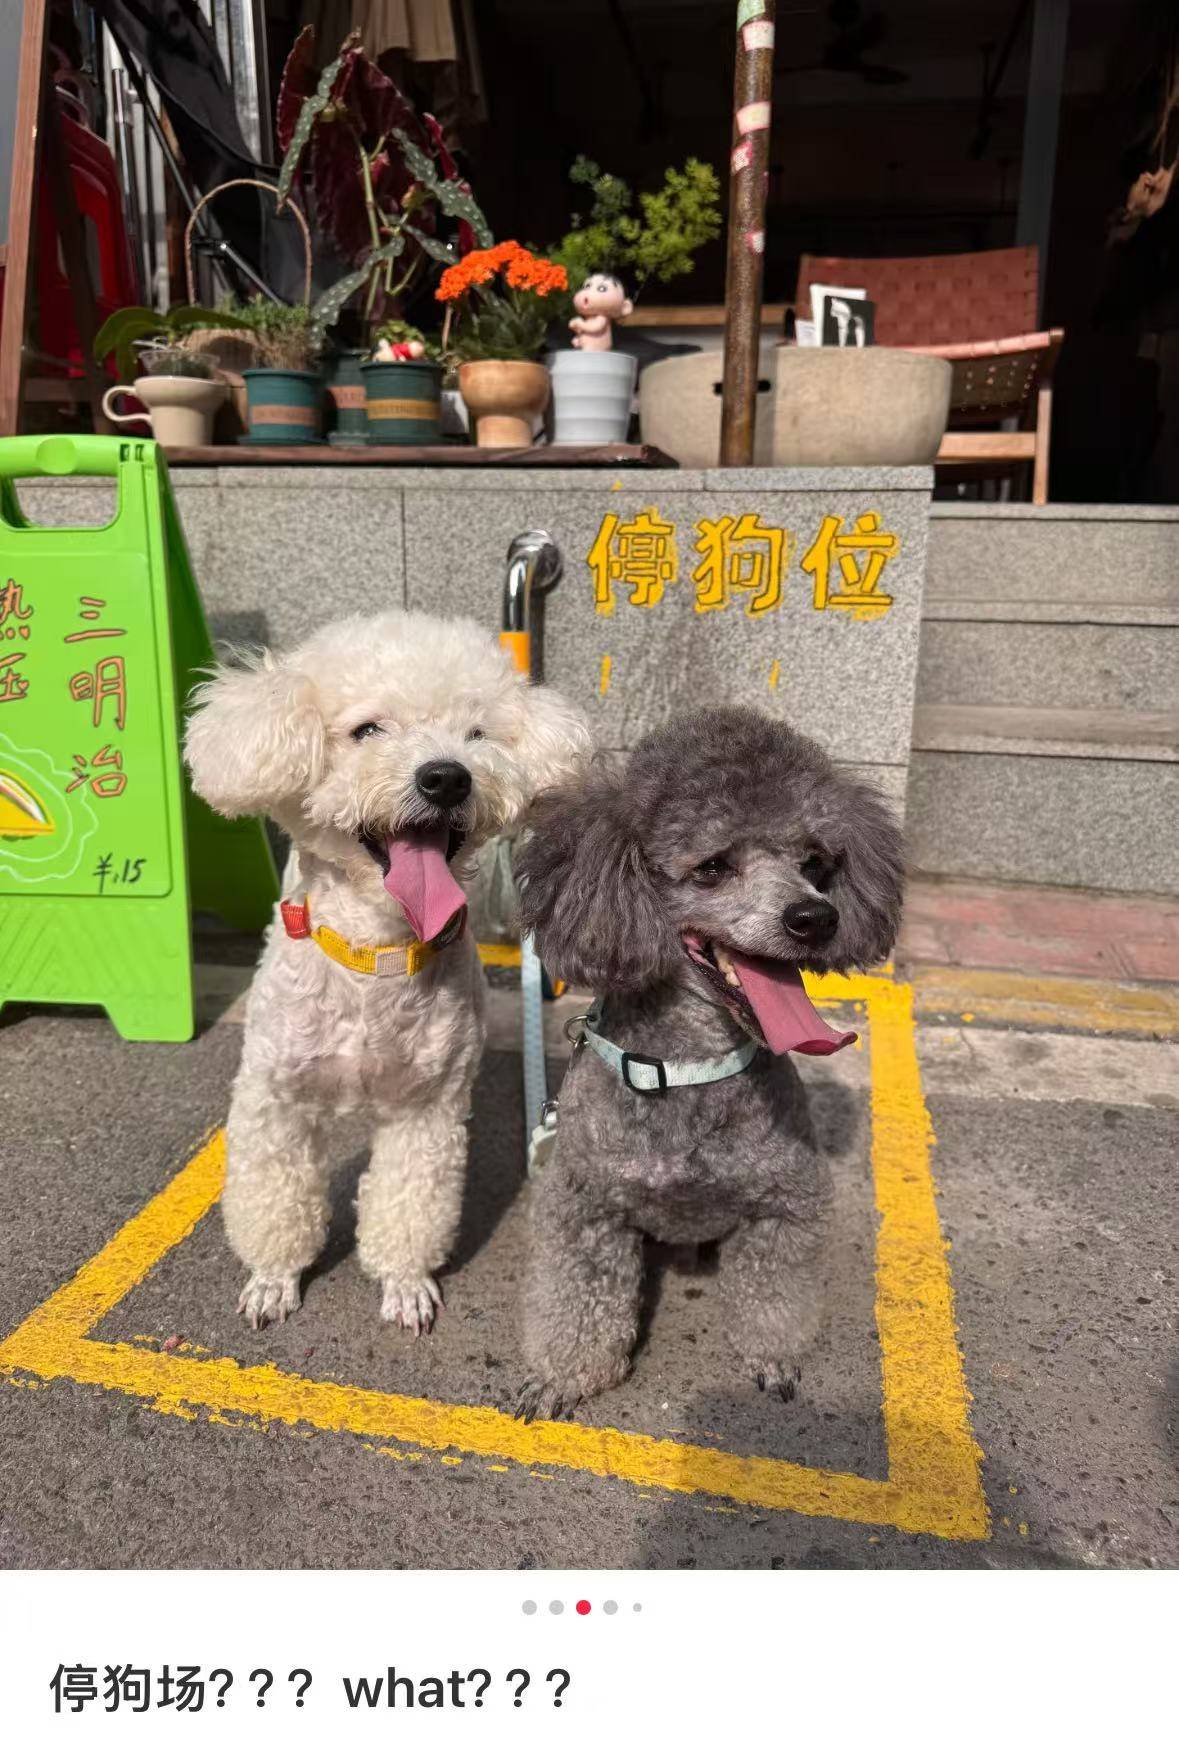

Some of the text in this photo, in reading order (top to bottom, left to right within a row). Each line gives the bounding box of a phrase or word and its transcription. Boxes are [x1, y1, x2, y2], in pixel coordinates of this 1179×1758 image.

[587, 510, 897, 616] 停狗位
[64, 597, 127, 798] 三明治
